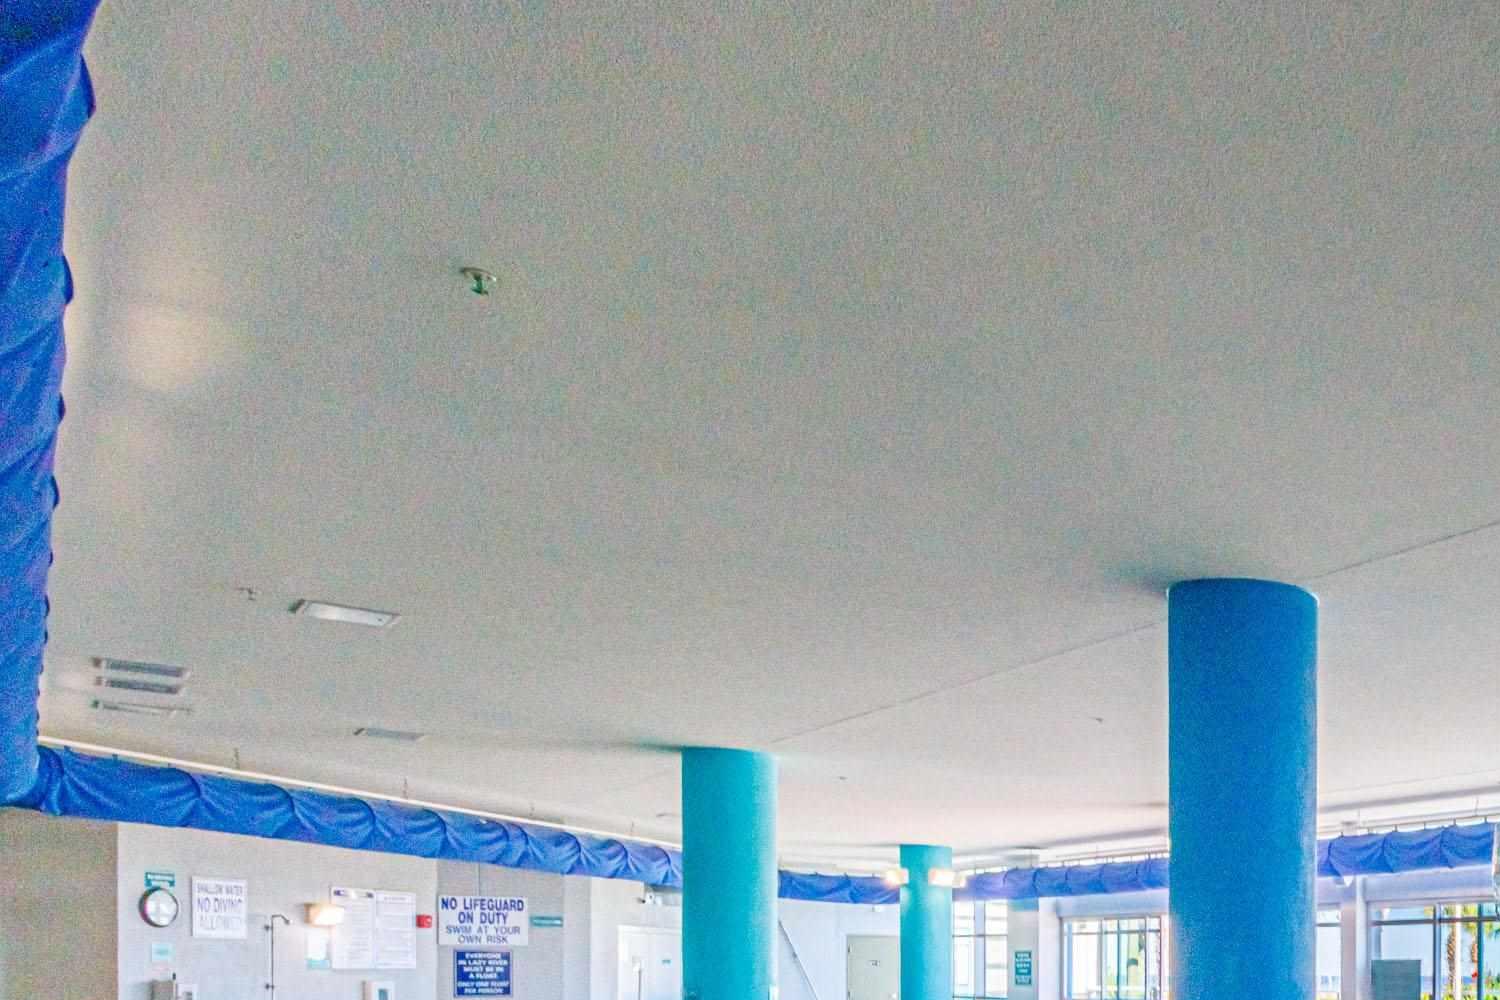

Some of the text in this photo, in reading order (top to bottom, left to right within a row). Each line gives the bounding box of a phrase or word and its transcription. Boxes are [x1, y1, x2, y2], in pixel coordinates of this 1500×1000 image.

[197, 897, 210, 913] NO
[441, 897, 525, 912] NO LIFEGUARD
[458, 911, 509, 925] ON DUTY
[446, 925, 521, 935] SWIM AT YOUR
[457, 935, 509, 944] OWN RISK
